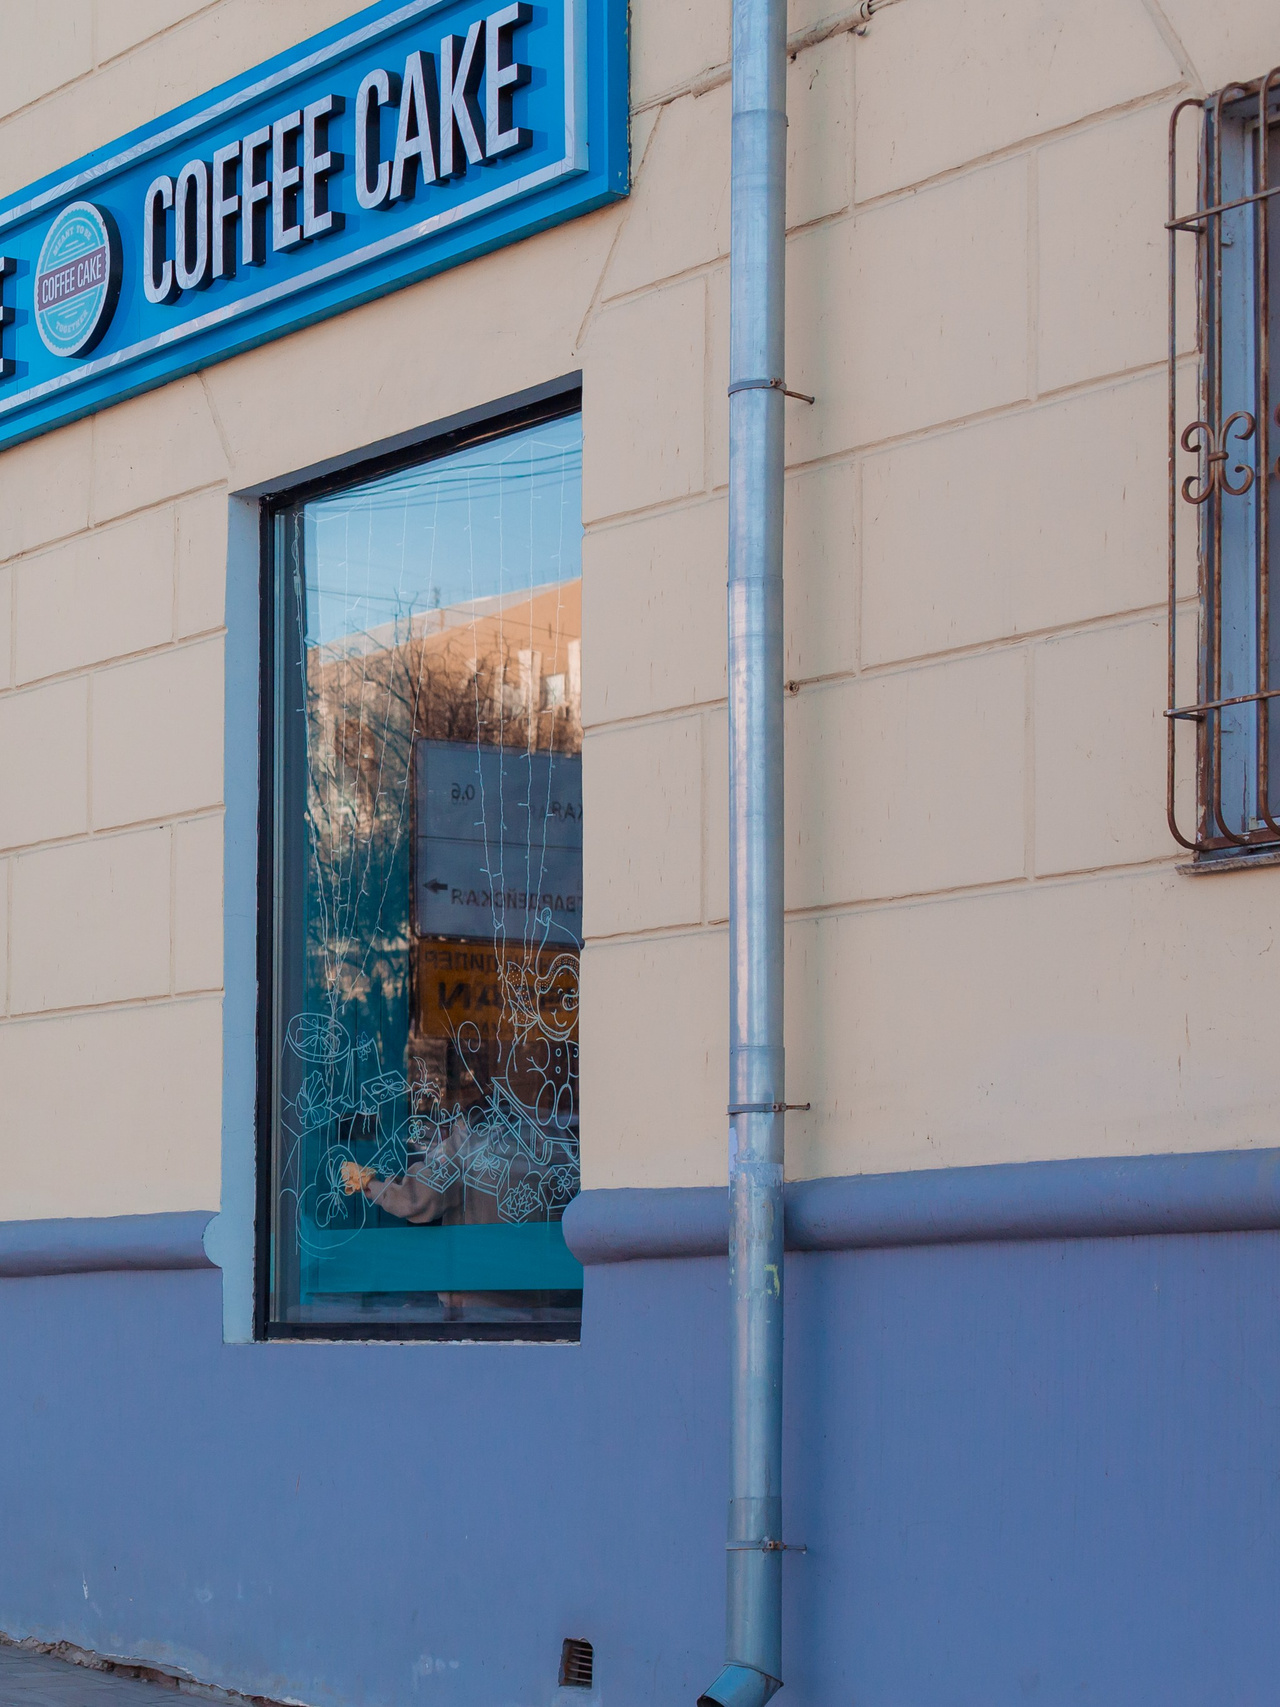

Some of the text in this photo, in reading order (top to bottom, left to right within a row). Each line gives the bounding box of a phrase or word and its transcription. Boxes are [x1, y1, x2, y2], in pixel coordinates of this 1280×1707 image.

[144, 3, 522, 305] COFFEE CAKE
[42, 253, 102, 304] COFFEE CAKE
